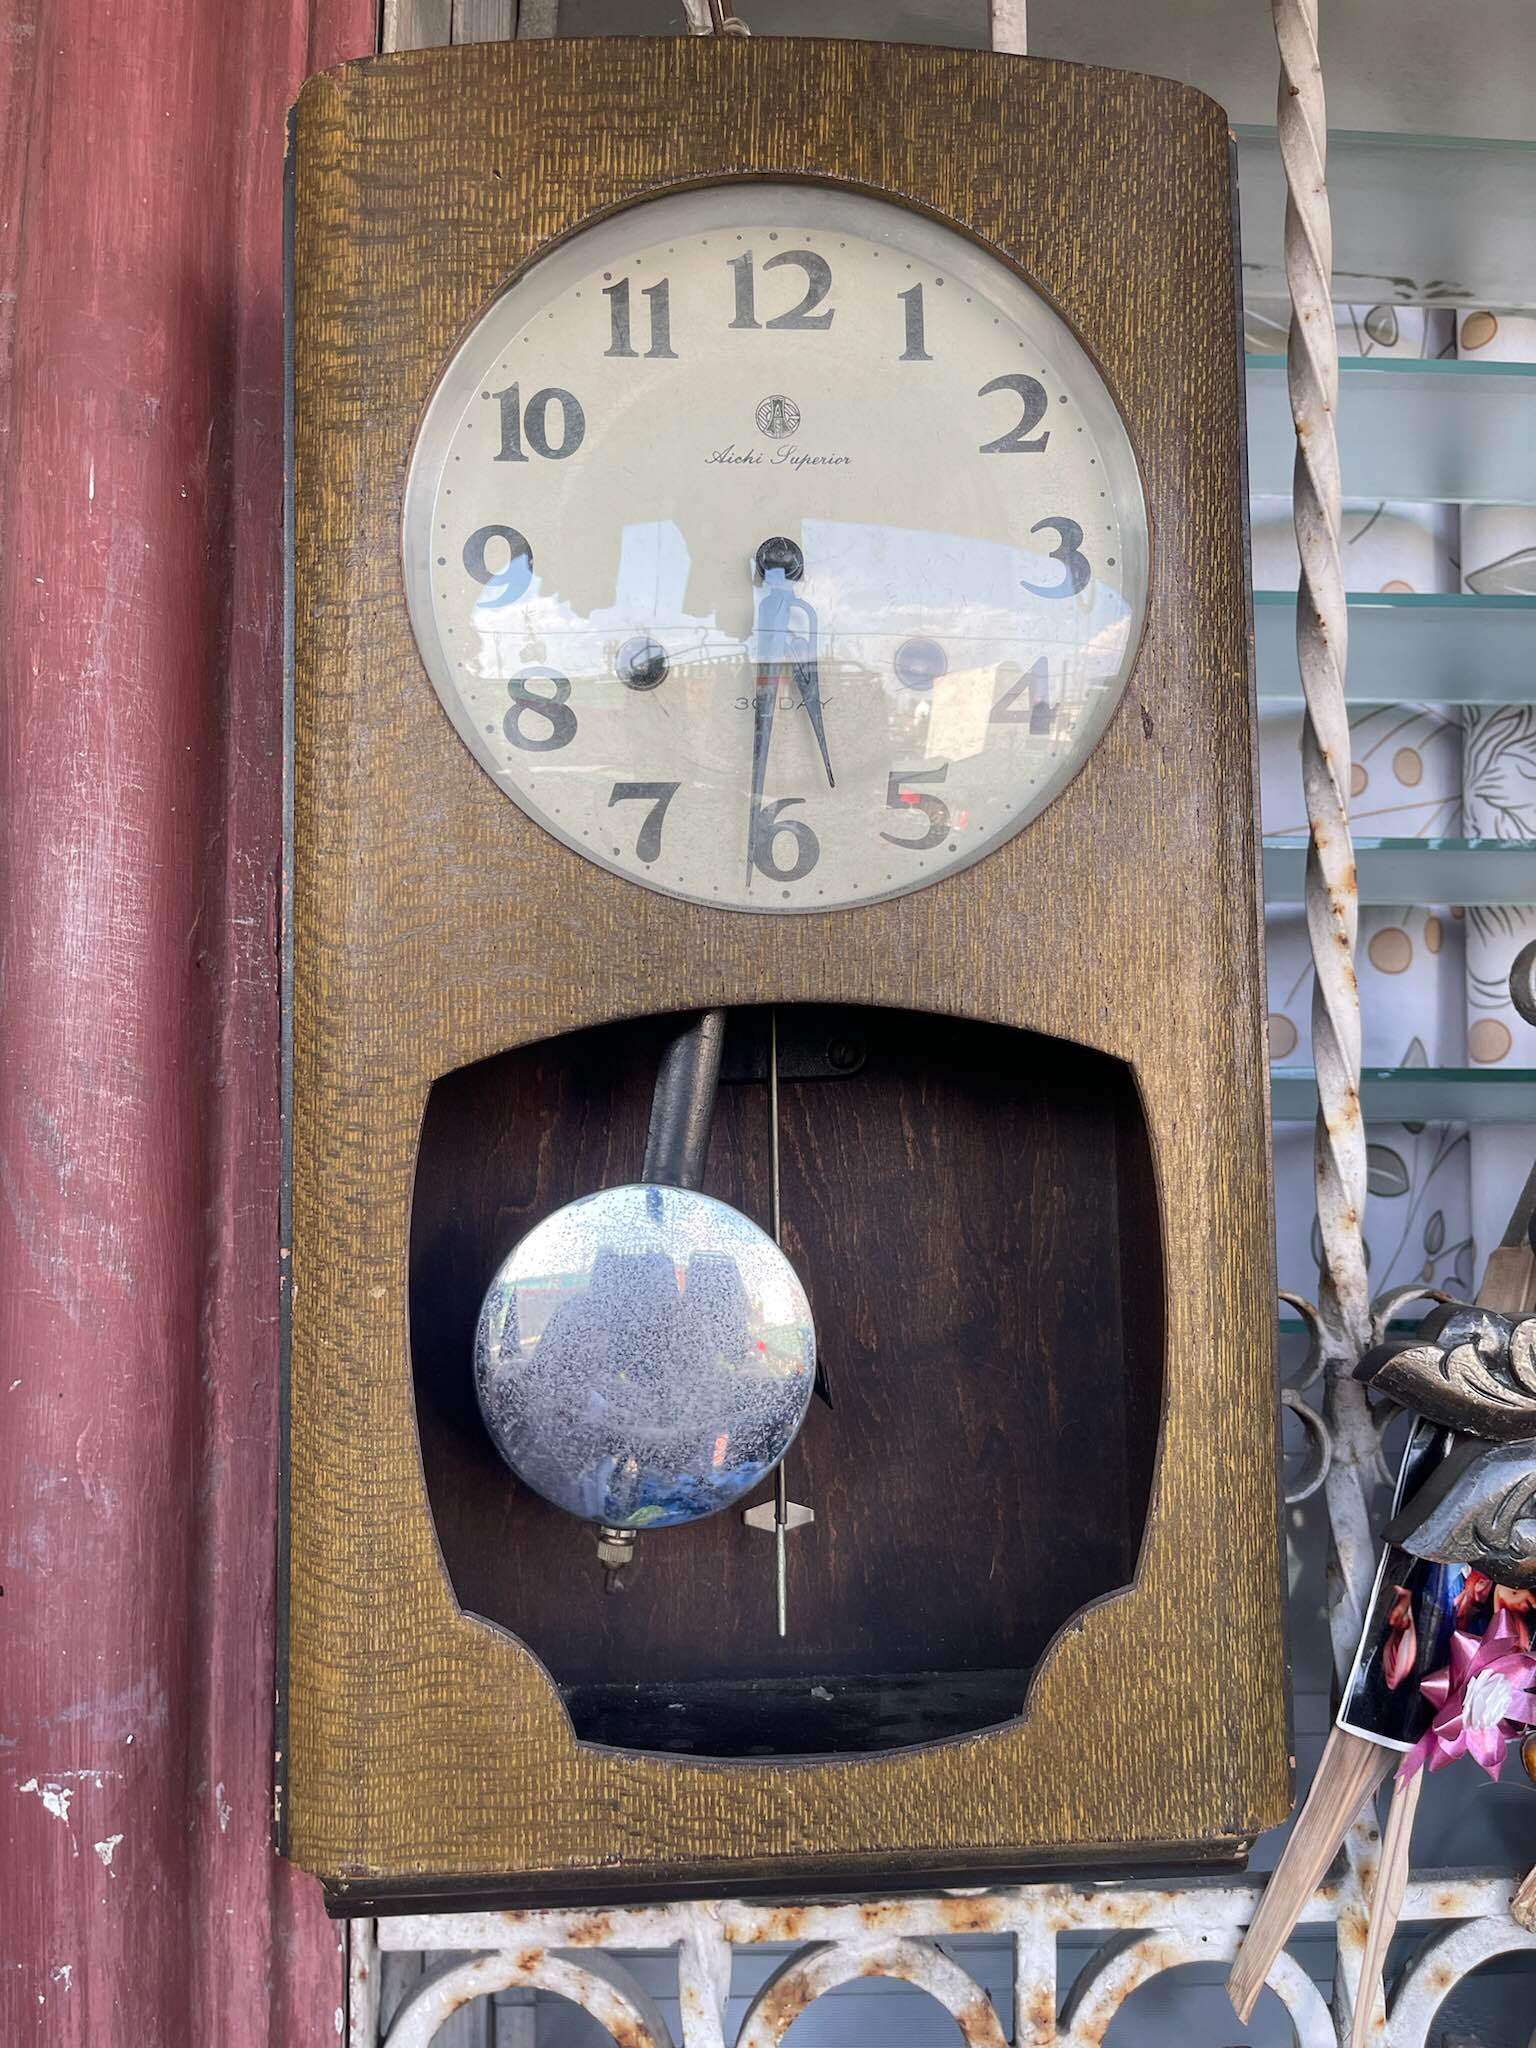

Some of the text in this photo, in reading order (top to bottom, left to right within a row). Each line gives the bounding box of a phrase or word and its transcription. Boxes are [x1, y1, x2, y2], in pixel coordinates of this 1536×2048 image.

[602, 277, 679, 359] 11
[727, 249, 835, 329] 12
[897, 282, 934, 361] 1
[491, 381, 586, 463] 10
[977, 374, 1051, 454] 2
[704, 444, 853, 471] Aichi Superior
[462, 524, 534, 608] 9
[1020, 516, 1092, 599] 3
[503, 666, 578, 751] 8
[988, 656, 1059, 735] 4
[607, 782, 682, 862] 7
[752, 797, 820, 882] 6
[879, 762, 951, 850] 5
